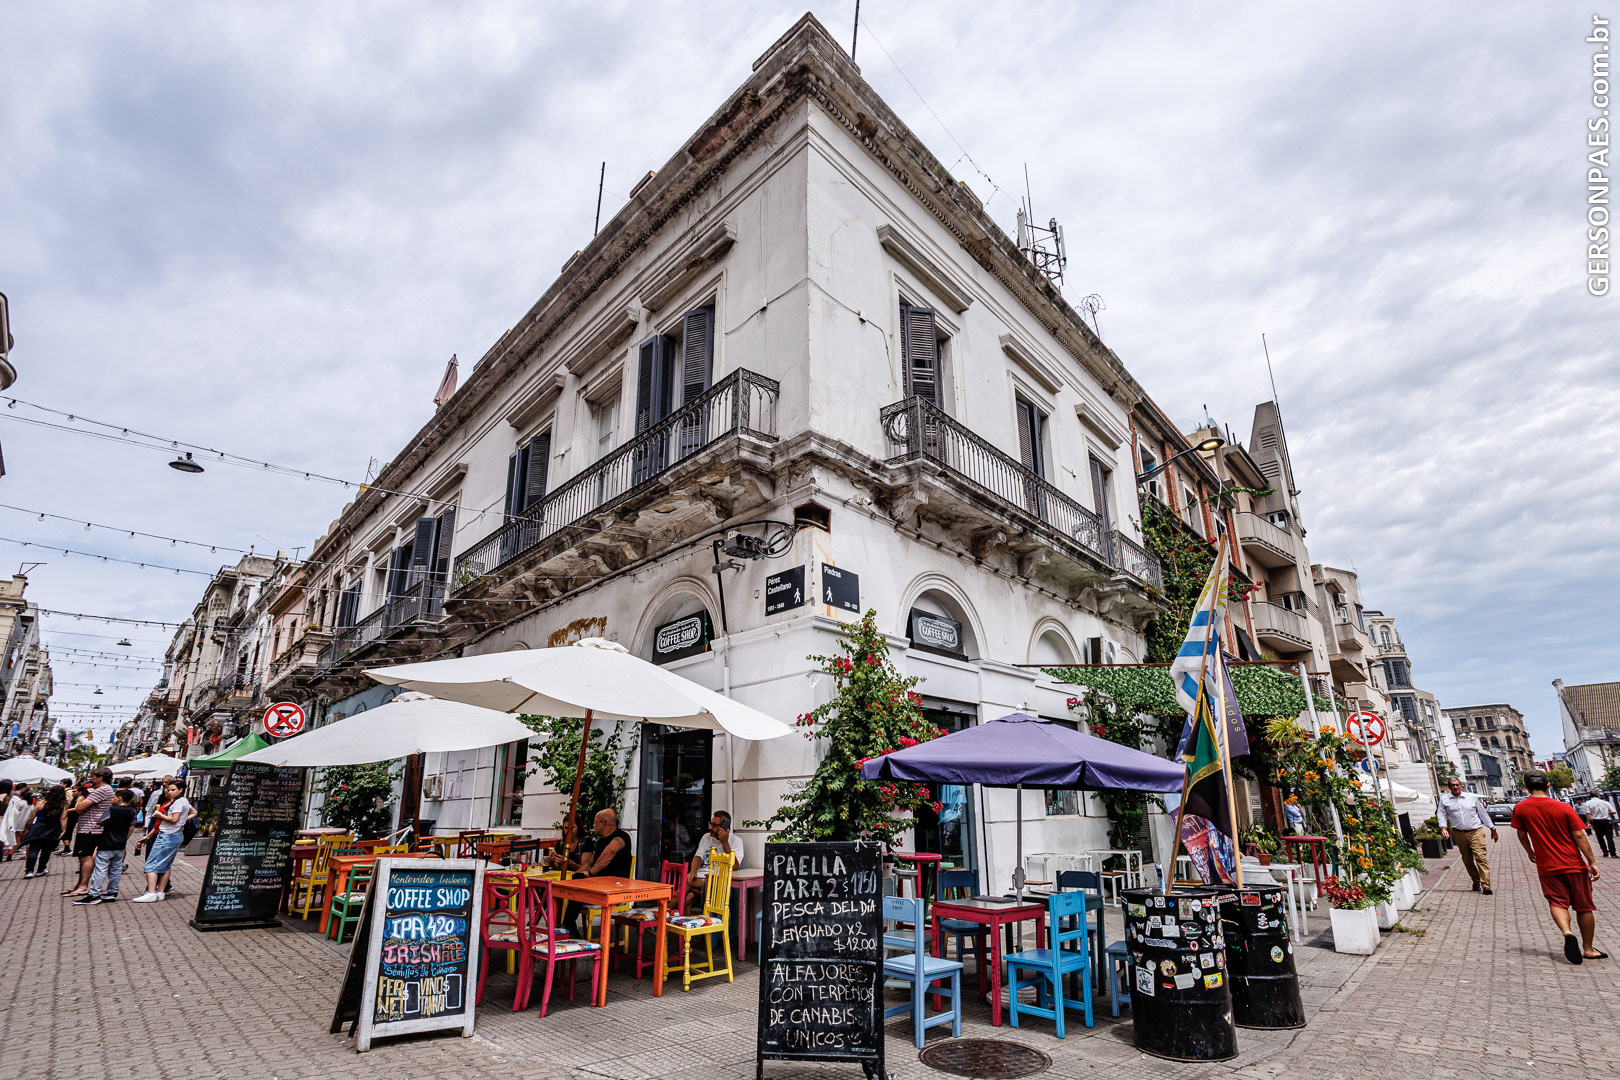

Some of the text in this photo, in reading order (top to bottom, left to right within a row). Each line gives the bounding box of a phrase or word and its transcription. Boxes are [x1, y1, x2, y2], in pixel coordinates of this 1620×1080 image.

[767, 576, 781, 587] Pérez
[823, 565, 842, 579] Piedras
[767, 582, 792, 595] Castellano
[660, 632, 681, 648] COFFEE
[681, 627, 698, 641] SHOP
[773, 855, 847, 876] PAELLA
[390, 873, 435, 884] Montevideo
[773, 878, 822, 900] PARA
[826, 877, 839, 898] 2
[386, 888, 471, 909] COFFEE SHOP
[771, 901, 824, 922] PESCA
[831, 900, 858, 915] DEL
[391, 915, 455, 939] IPA 420
[771, 923, 843, 949] LENGUADO
[384, 942, 463, 964] IRISH RED
[441, 950, 464, 962] ALE
[772, 963, 868, 983] ALFAJORES
[769, 984, 875, 1004] CON TERPENOS
[769, 1007, 855, 1026] DE CANABIS
